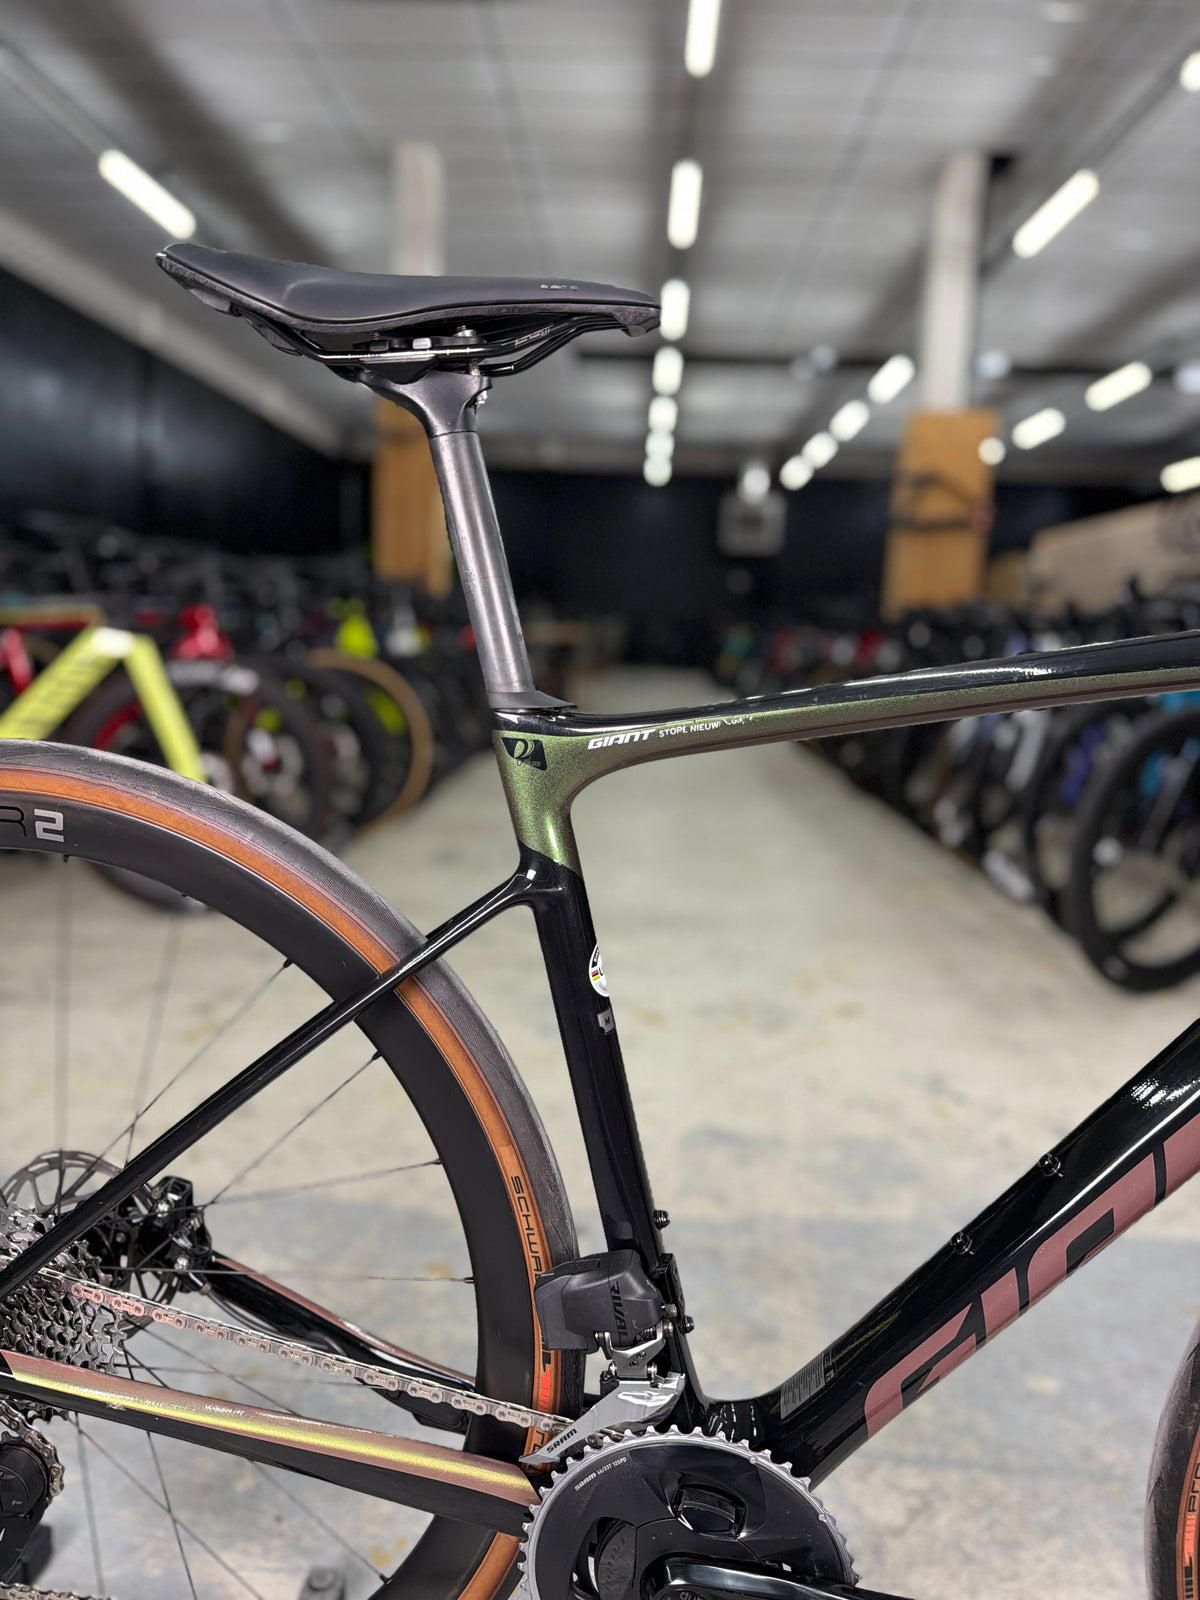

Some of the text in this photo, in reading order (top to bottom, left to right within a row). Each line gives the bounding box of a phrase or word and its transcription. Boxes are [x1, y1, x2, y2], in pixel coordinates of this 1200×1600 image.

[587, 729, 656, 750] GIANT
[610, 1281, 628, 1336] RIVAL
[546, 1428, 578, 1454] SRAM
[575, 1473, 597, 1491] SRAM
